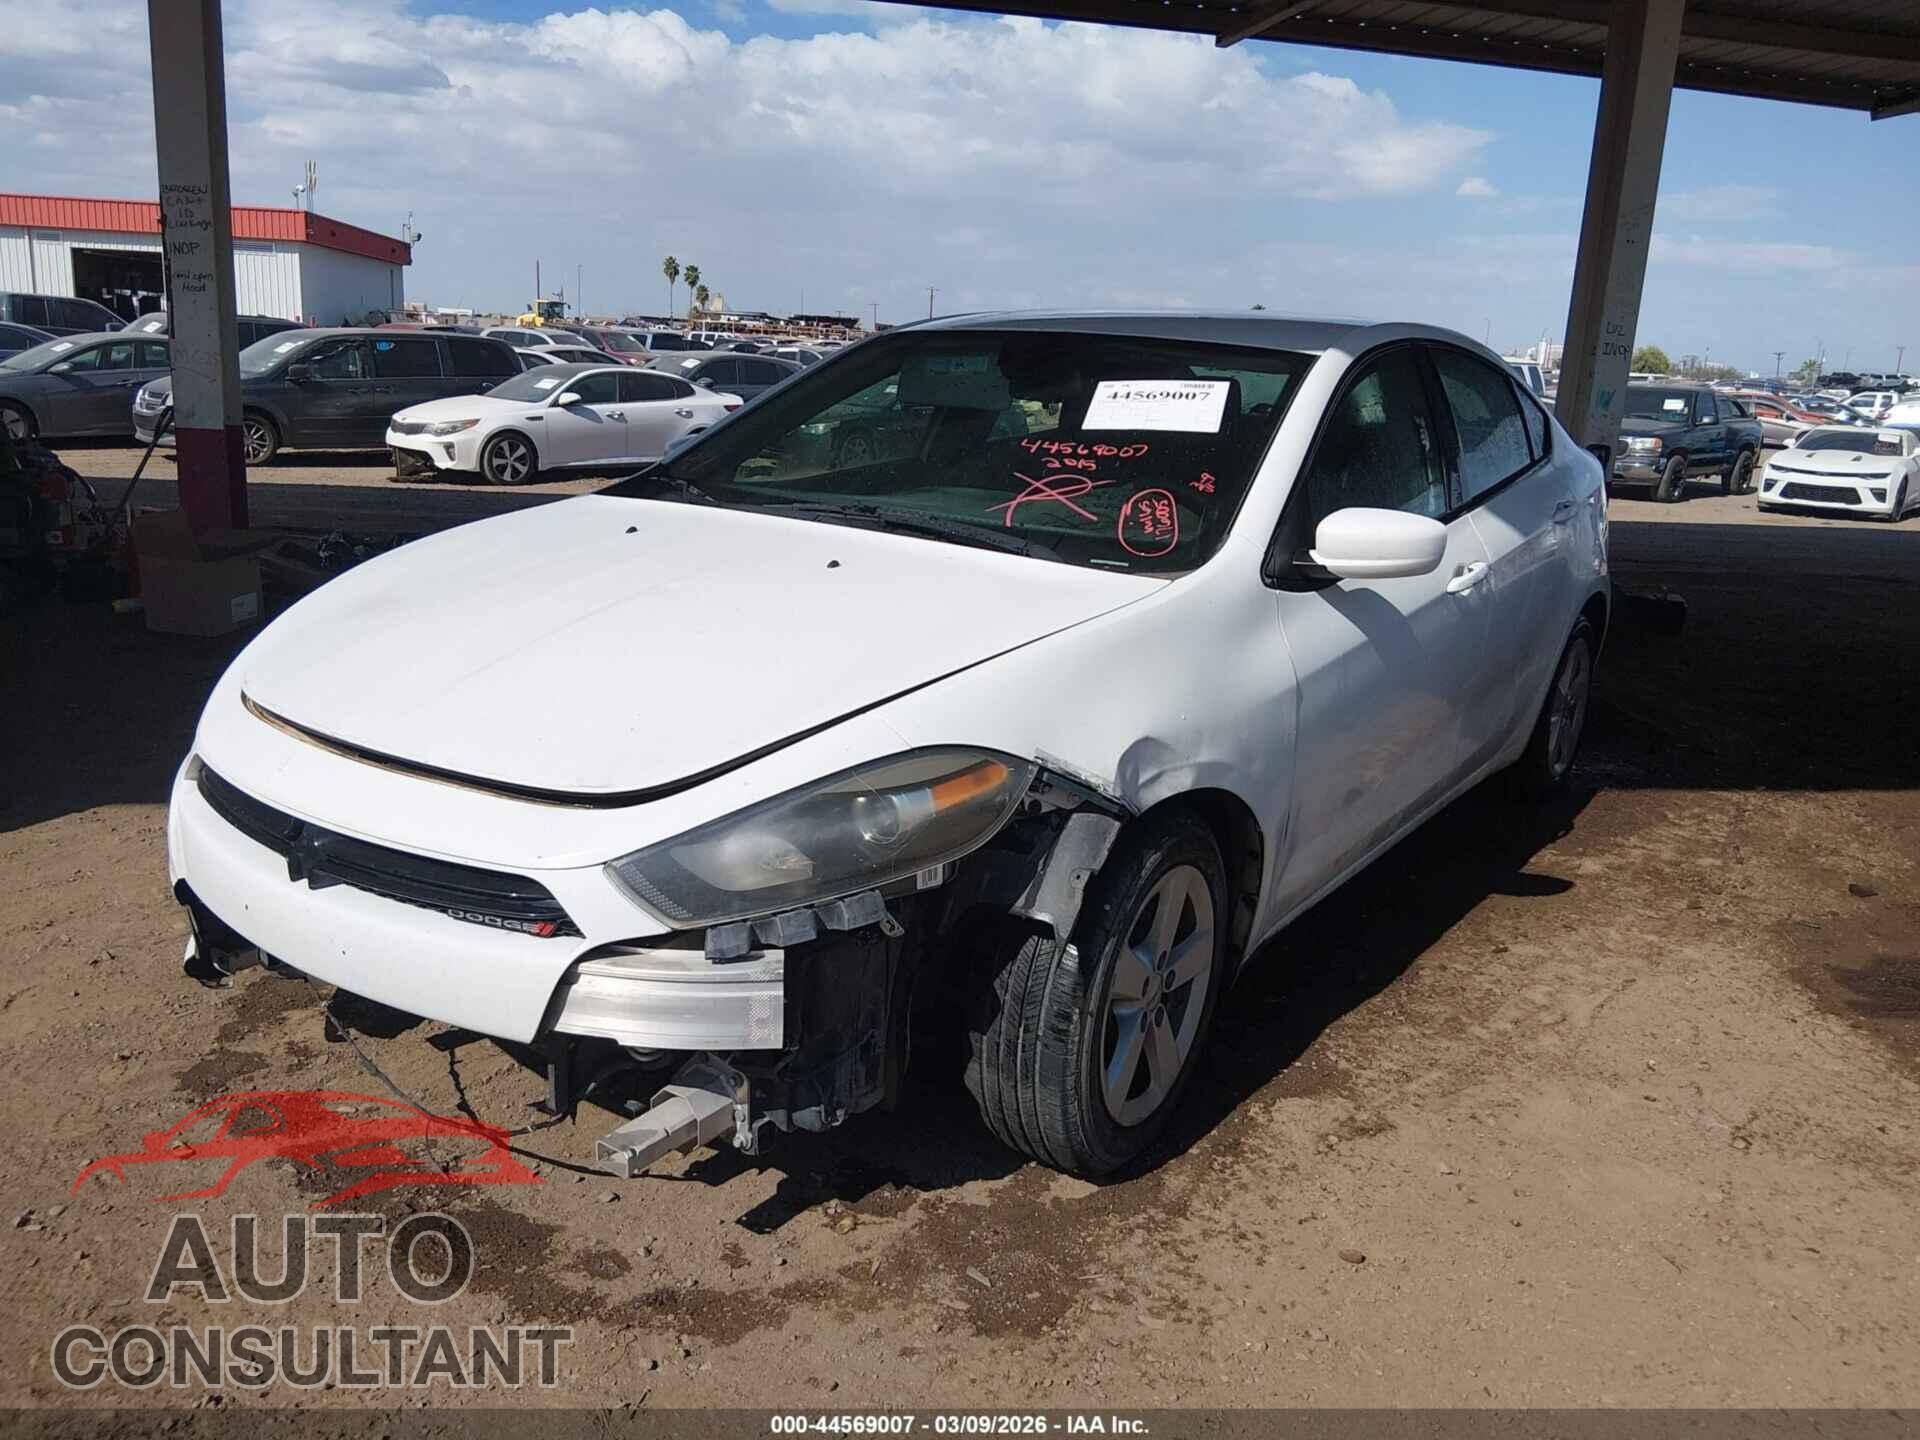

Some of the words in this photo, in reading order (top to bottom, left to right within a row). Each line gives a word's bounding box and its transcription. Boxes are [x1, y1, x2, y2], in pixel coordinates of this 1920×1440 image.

[1106, 390, 1211, 401] 44569007
[1021, 438, 1148, 457] 44569007
[1041, 457, 1097, 471] 2015
[447, 908, 541, 934] DODGE
